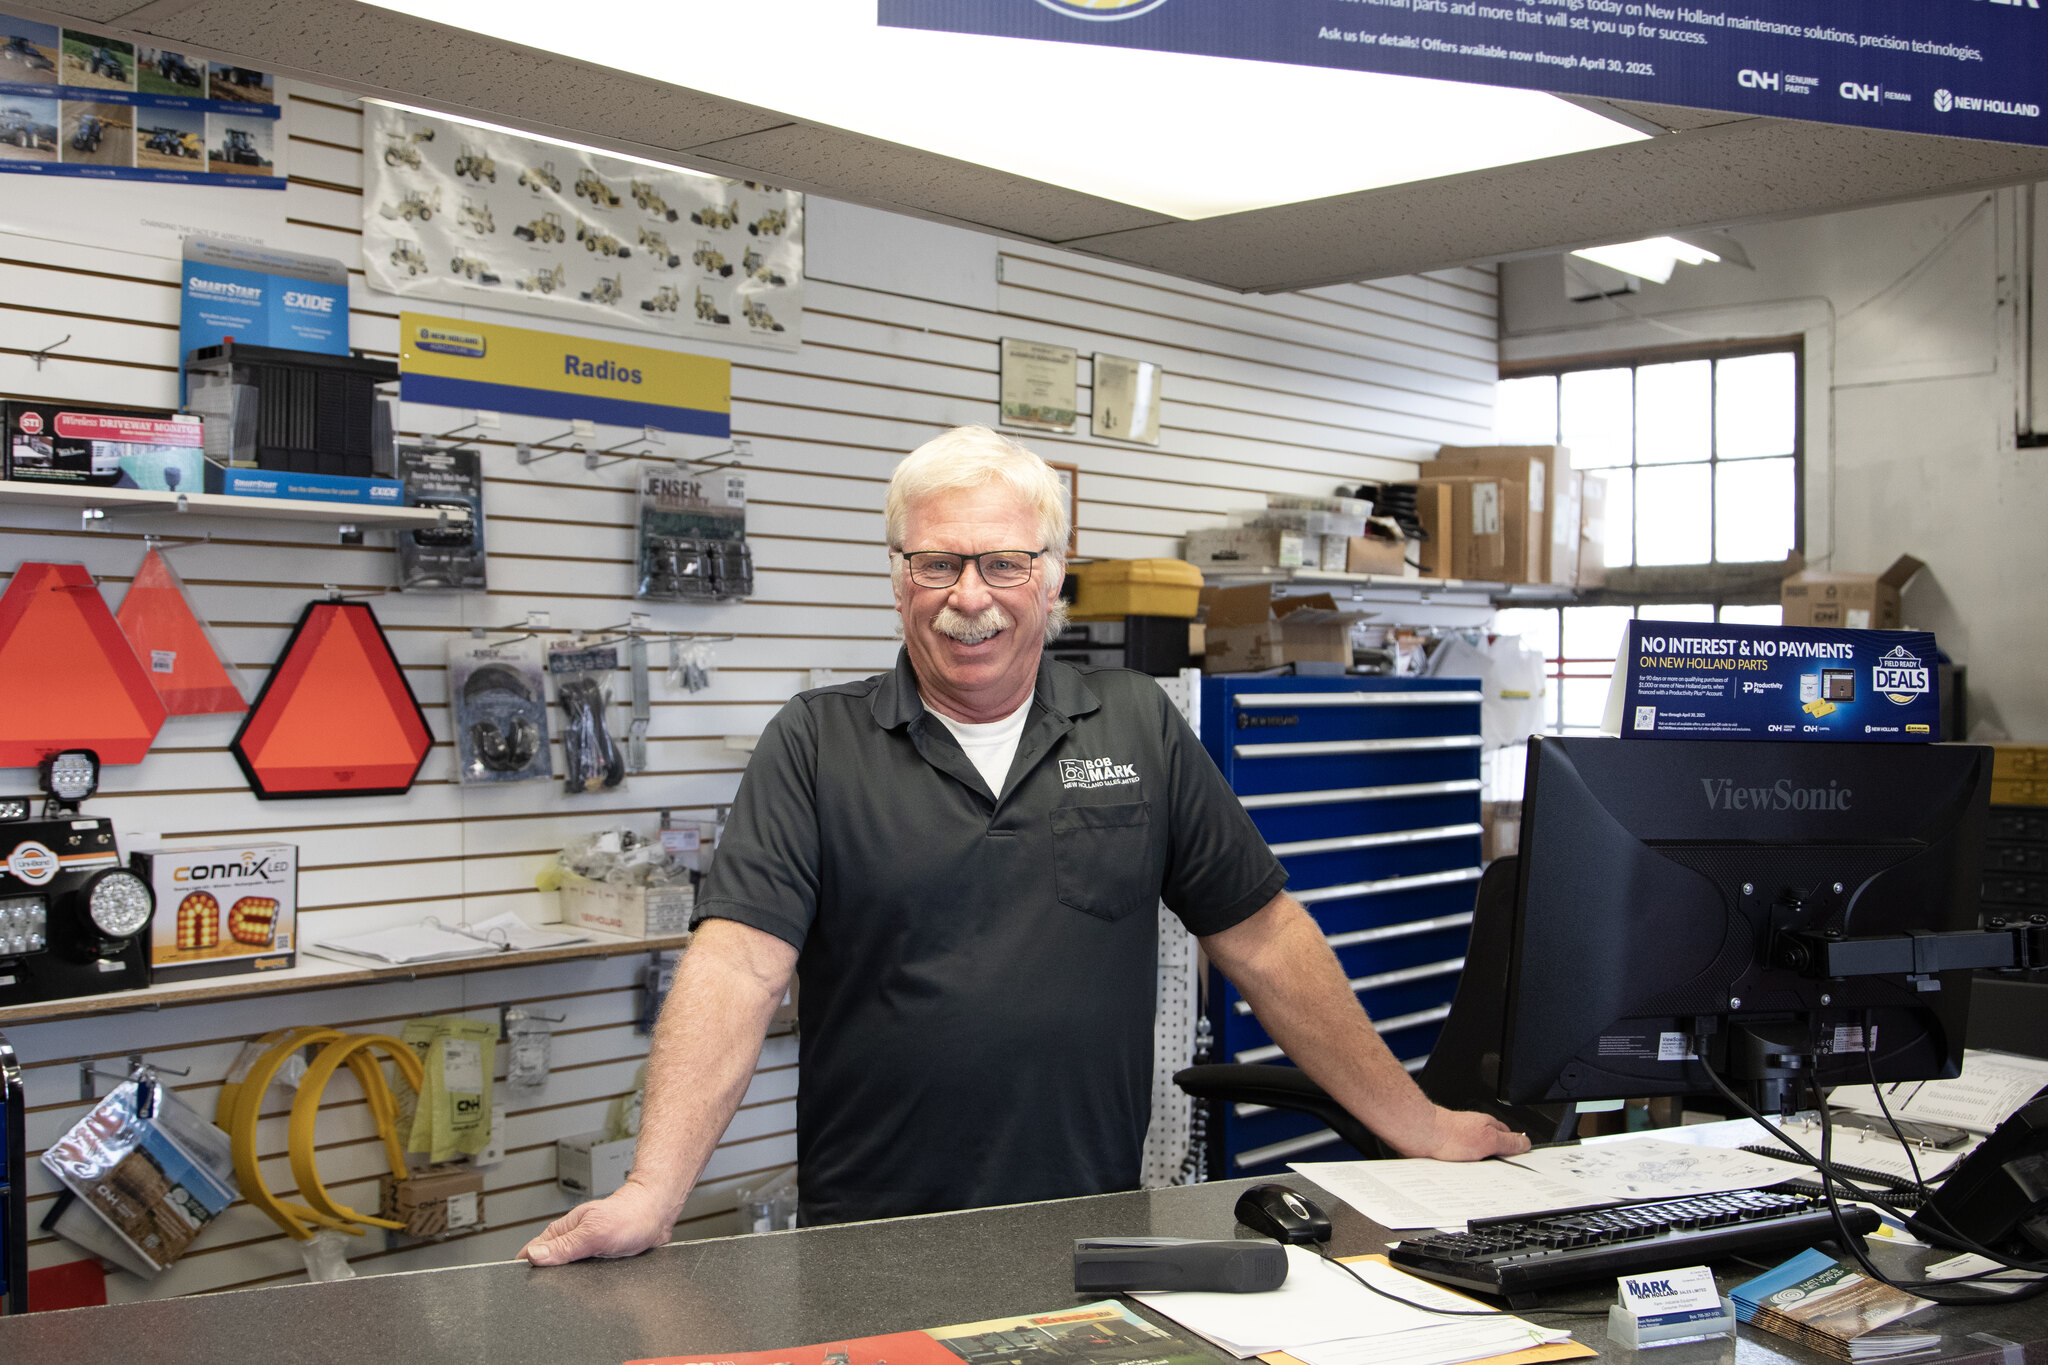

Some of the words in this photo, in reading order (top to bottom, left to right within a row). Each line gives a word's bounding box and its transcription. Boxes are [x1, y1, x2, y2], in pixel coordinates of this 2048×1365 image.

[1412, 0, 1448, 12] parts
[1450, 2, 1476, 16] and
[1478, 6, 1513, 20] more
[1515, 8, 1543, 24] that
[1545, 11, 1567, 28] will
[1569, 15, 1590, 30] set
[1592, 19, 1616, 34] you
[1618, 23, 1636, 38] up
[1637, 22, 1657, 38] for
[1658, 27, 1708, 45] success.
[1586, 0, 1623, 16] today
[1625, 3, 1643, 16] on
[1644, 3, 1675, 20] New
[1677, 6, 1725, 27] Holland
[1727, 15, 1802, 36] maintenance
[1803, 25, 1858, 46] solutions,
[1859, 32, 1910, 51] precision
[1911, 39, 1983, 62] technologies,
[1318, 26, 1342, 40] Ask
[1343, 30, 1358, 42] us
[1359, 30, 1377, 44] for
[1378, 33, 1420, 49] details!
[1421, 38, 1458, 53] Offers
[1459, 43, 1507, 58] available
[1509, 51, 1533, 62] now
[1535, 50, 1577, 69] through
[1579, 56, 1605, 71] April
[1606, 59, 1624, 73] 30,
[1626, 61, 1656, 76] 2025.
[1737, 68, 1779, 91] CNH
[1784, 74, 1819, 86] GENUINE
[1784, 84, 1810, 95] PARTS
[1839, 81, 1879, 102] CNH
[1884, 91, 1912, 101] REMAN
[1954, 95, 1982, 111] NEW
[1983, 99, 2040, 118] HOLLAND
[282, 291, 336, 312] EXIDE
[564, 354, 643, 385] Radios
[22, 418, 40, 428] STI
[62, 415, 98, 427] Wireless
[100, 418, 152, 431] DRIVEWAY
[154, 423, 200, 434] MONITOR
[644, 478, 700, 498] JENSEN
[1641, 636, 1666, 653] NO
[1739, 640, 1751, 656] &
[1753, 640, 1777, 656] NO
[1640, 656, 1656, 668] ON
[1659, 657, 1685, 669] NEW
[1686, 658, 1736, 670] HOLLAND
[1737, 659, 1768, 671] PARTS
[1753, 682, 1783, 690] Productivity
[1876, 670, 1926, 689] DEALS
[1767, 724, 1783, 732] CNH
[1085, 757, 1113, 769] BOB
[1088, 763, 1137, 782] MARK
[1063, 781, 1078, 789] NEW
[1078, 781, 1104, 789] HOLLAND
[1700, 778, 1853, 811] ViewSonic
[268, 861, 288, 872] LED
[1628, 1280, 1673, 1296] MARK
[1652, 1290, 1679, 1299] HOLLAND
